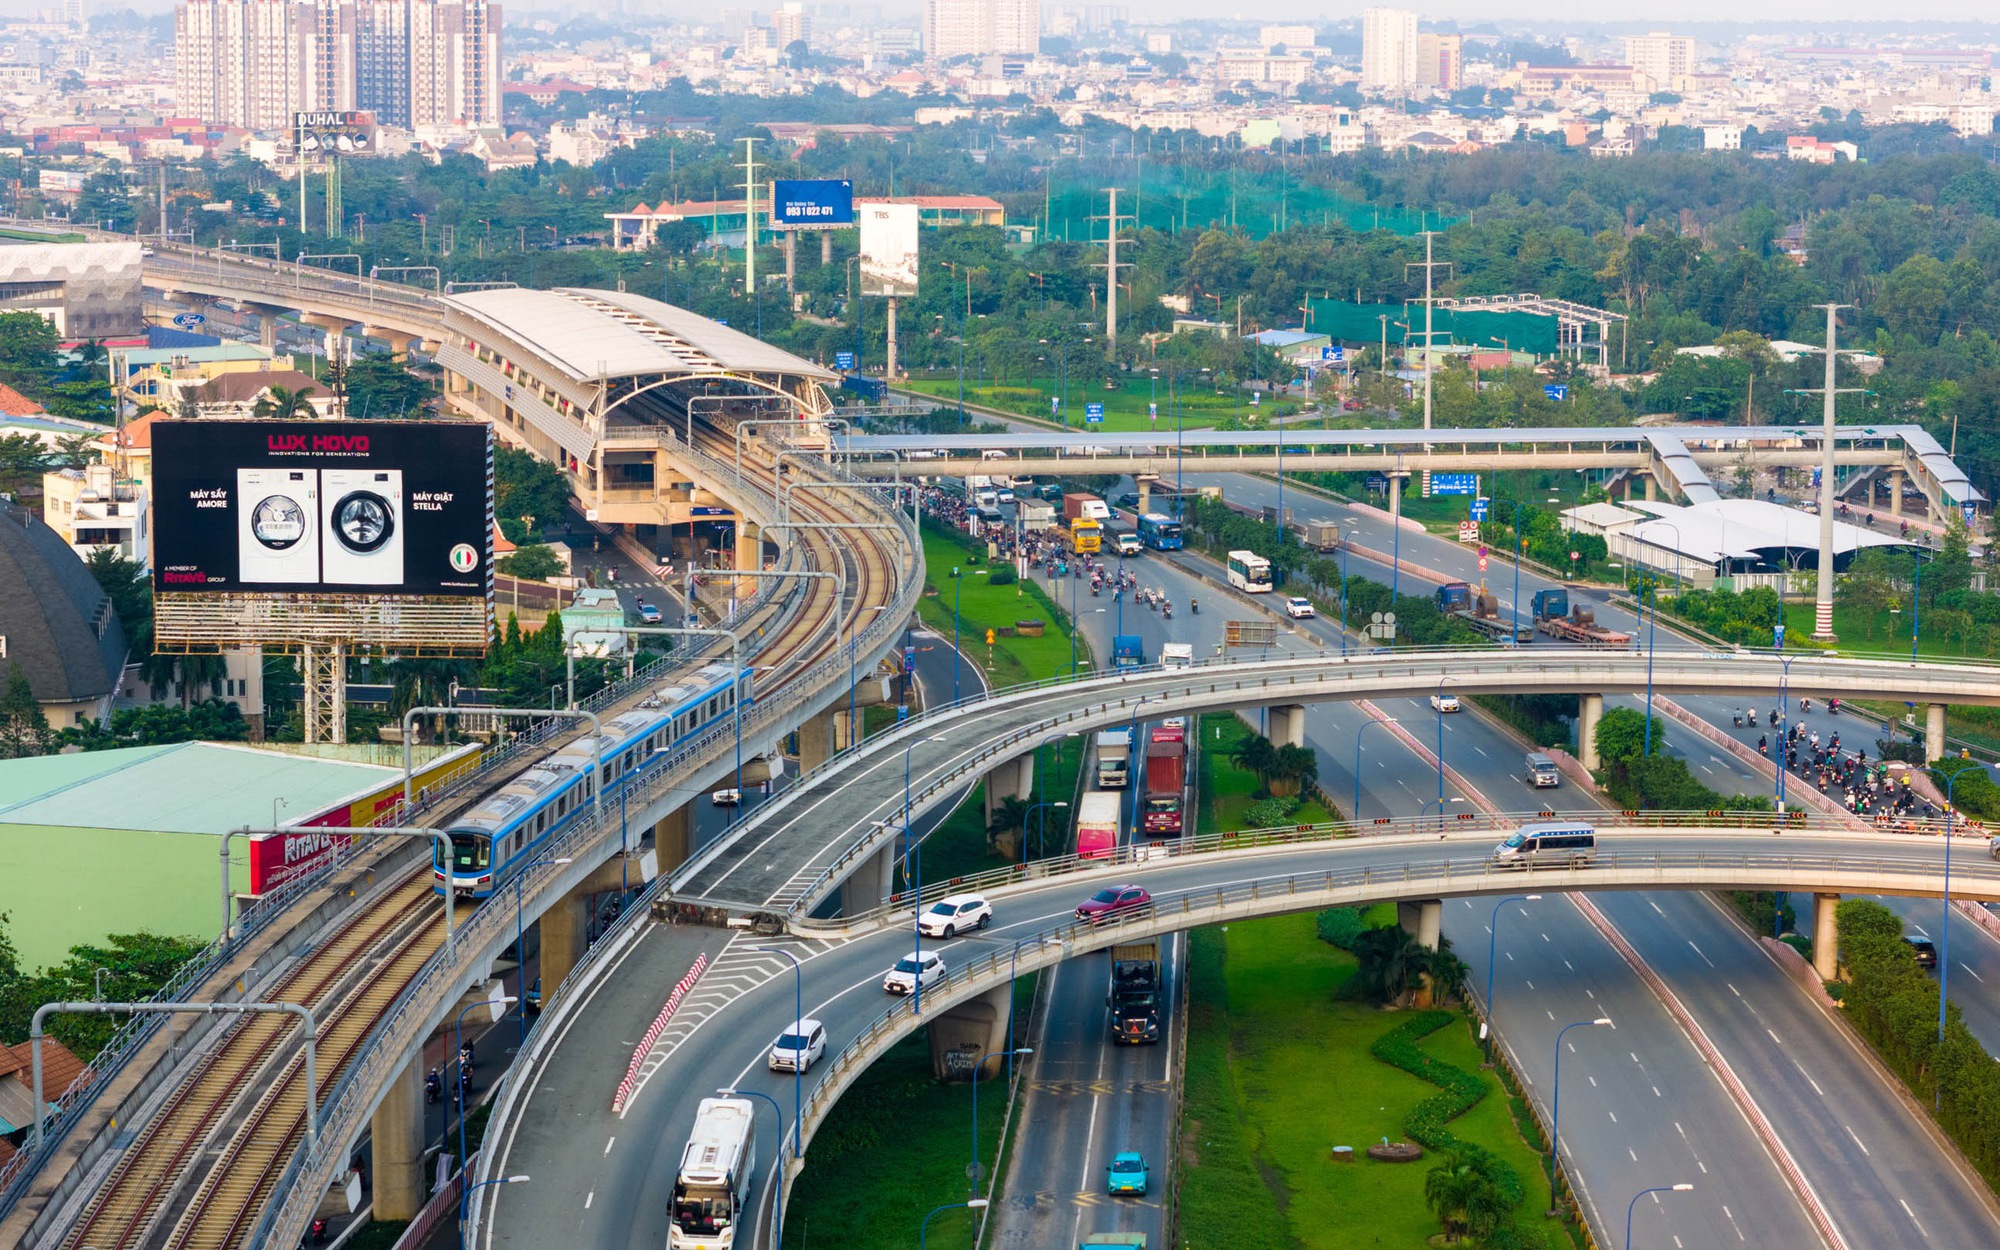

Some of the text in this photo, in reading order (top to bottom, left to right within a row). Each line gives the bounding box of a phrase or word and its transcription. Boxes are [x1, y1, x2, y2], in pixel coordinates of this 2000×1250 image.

[298, 113, 373, 125] DUHAL LED
[873, 211, 889, 219] TBS
[181, 315, 200, 324] Ford
[267, 435, 369, 451] LUX HOVO
[190, 489, 209, 499] MÁY
[413, 491, 453, 503] MÁY GIẶT
[196, 500, 227, 508] AMORE
[413, 502, 442, 511] STELLA
